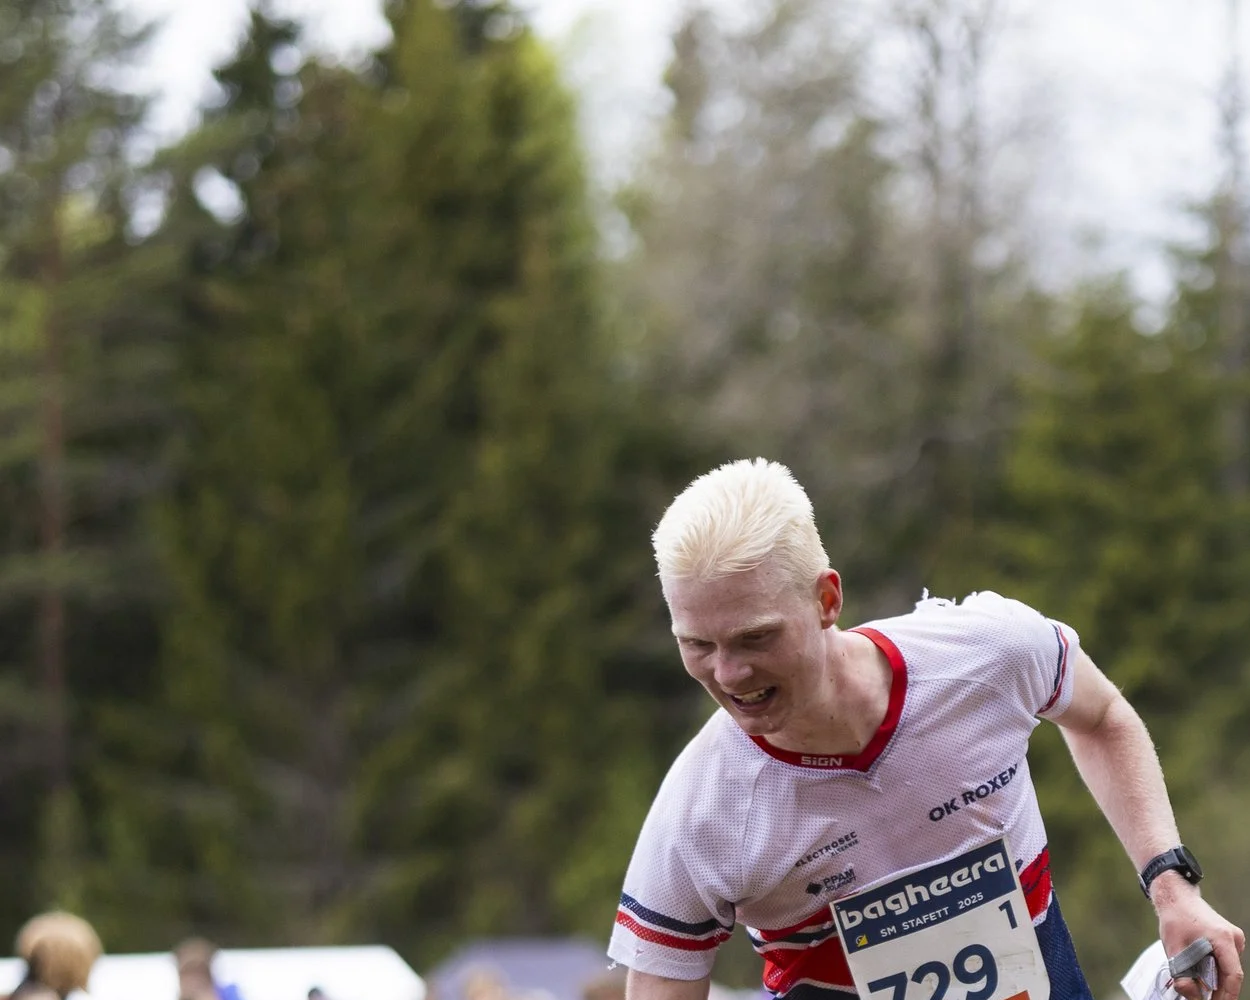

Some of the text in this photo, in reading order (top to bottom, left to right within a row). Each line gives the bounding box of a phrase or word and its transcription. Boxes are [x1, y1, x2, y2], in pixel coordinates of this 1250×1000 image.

[928, 797, 961, 822] OK
[839, 852, 1006, 931] bagheera
[880, 892, 984, 938] SM STAFETT 2025
[998, 900, 1018, 929] 1
